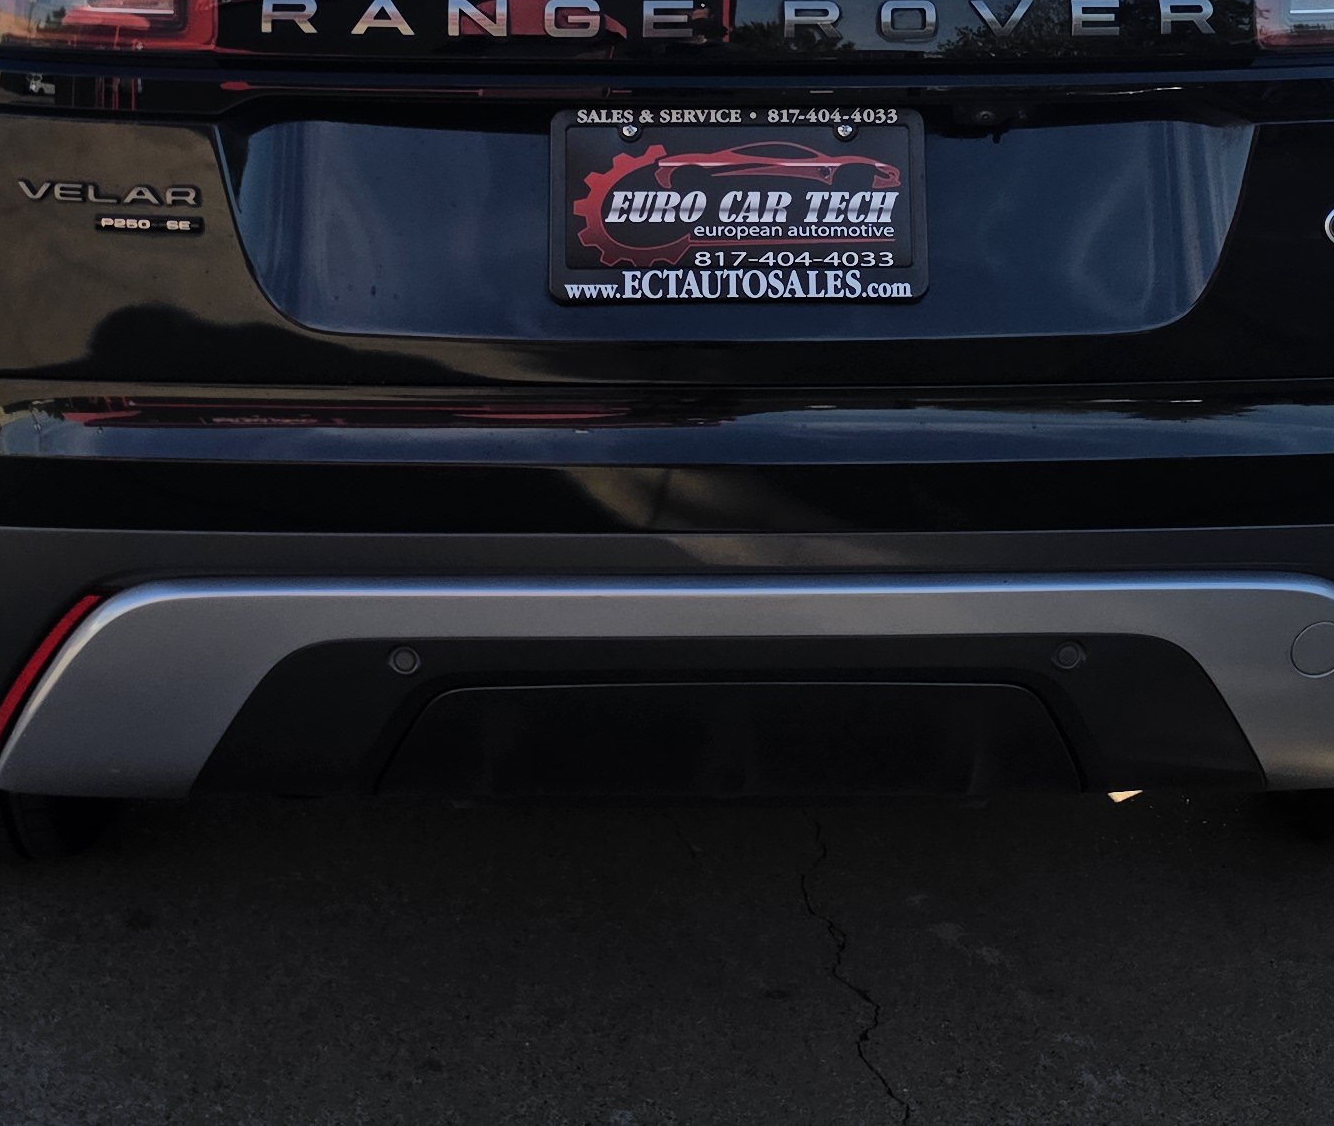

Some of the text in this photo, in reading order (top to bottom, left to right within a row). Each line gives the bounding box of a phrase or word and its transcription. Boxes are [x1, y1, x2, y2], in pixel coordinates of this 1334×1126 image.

[577, 108, 898, 124] SALES & SERVICE 817-404-4033
[18, 180, 197, 206] VELAR
[604, 190, 900, 223] EURO CAR TECH
[101, 217, 191, 231] P250 SE
[693, 224, 895, 240] european automotive
[694, 251, 895, 267] 817-404-4033
[564, 268, 913, 299] www.ECTAUTOSALES.com
